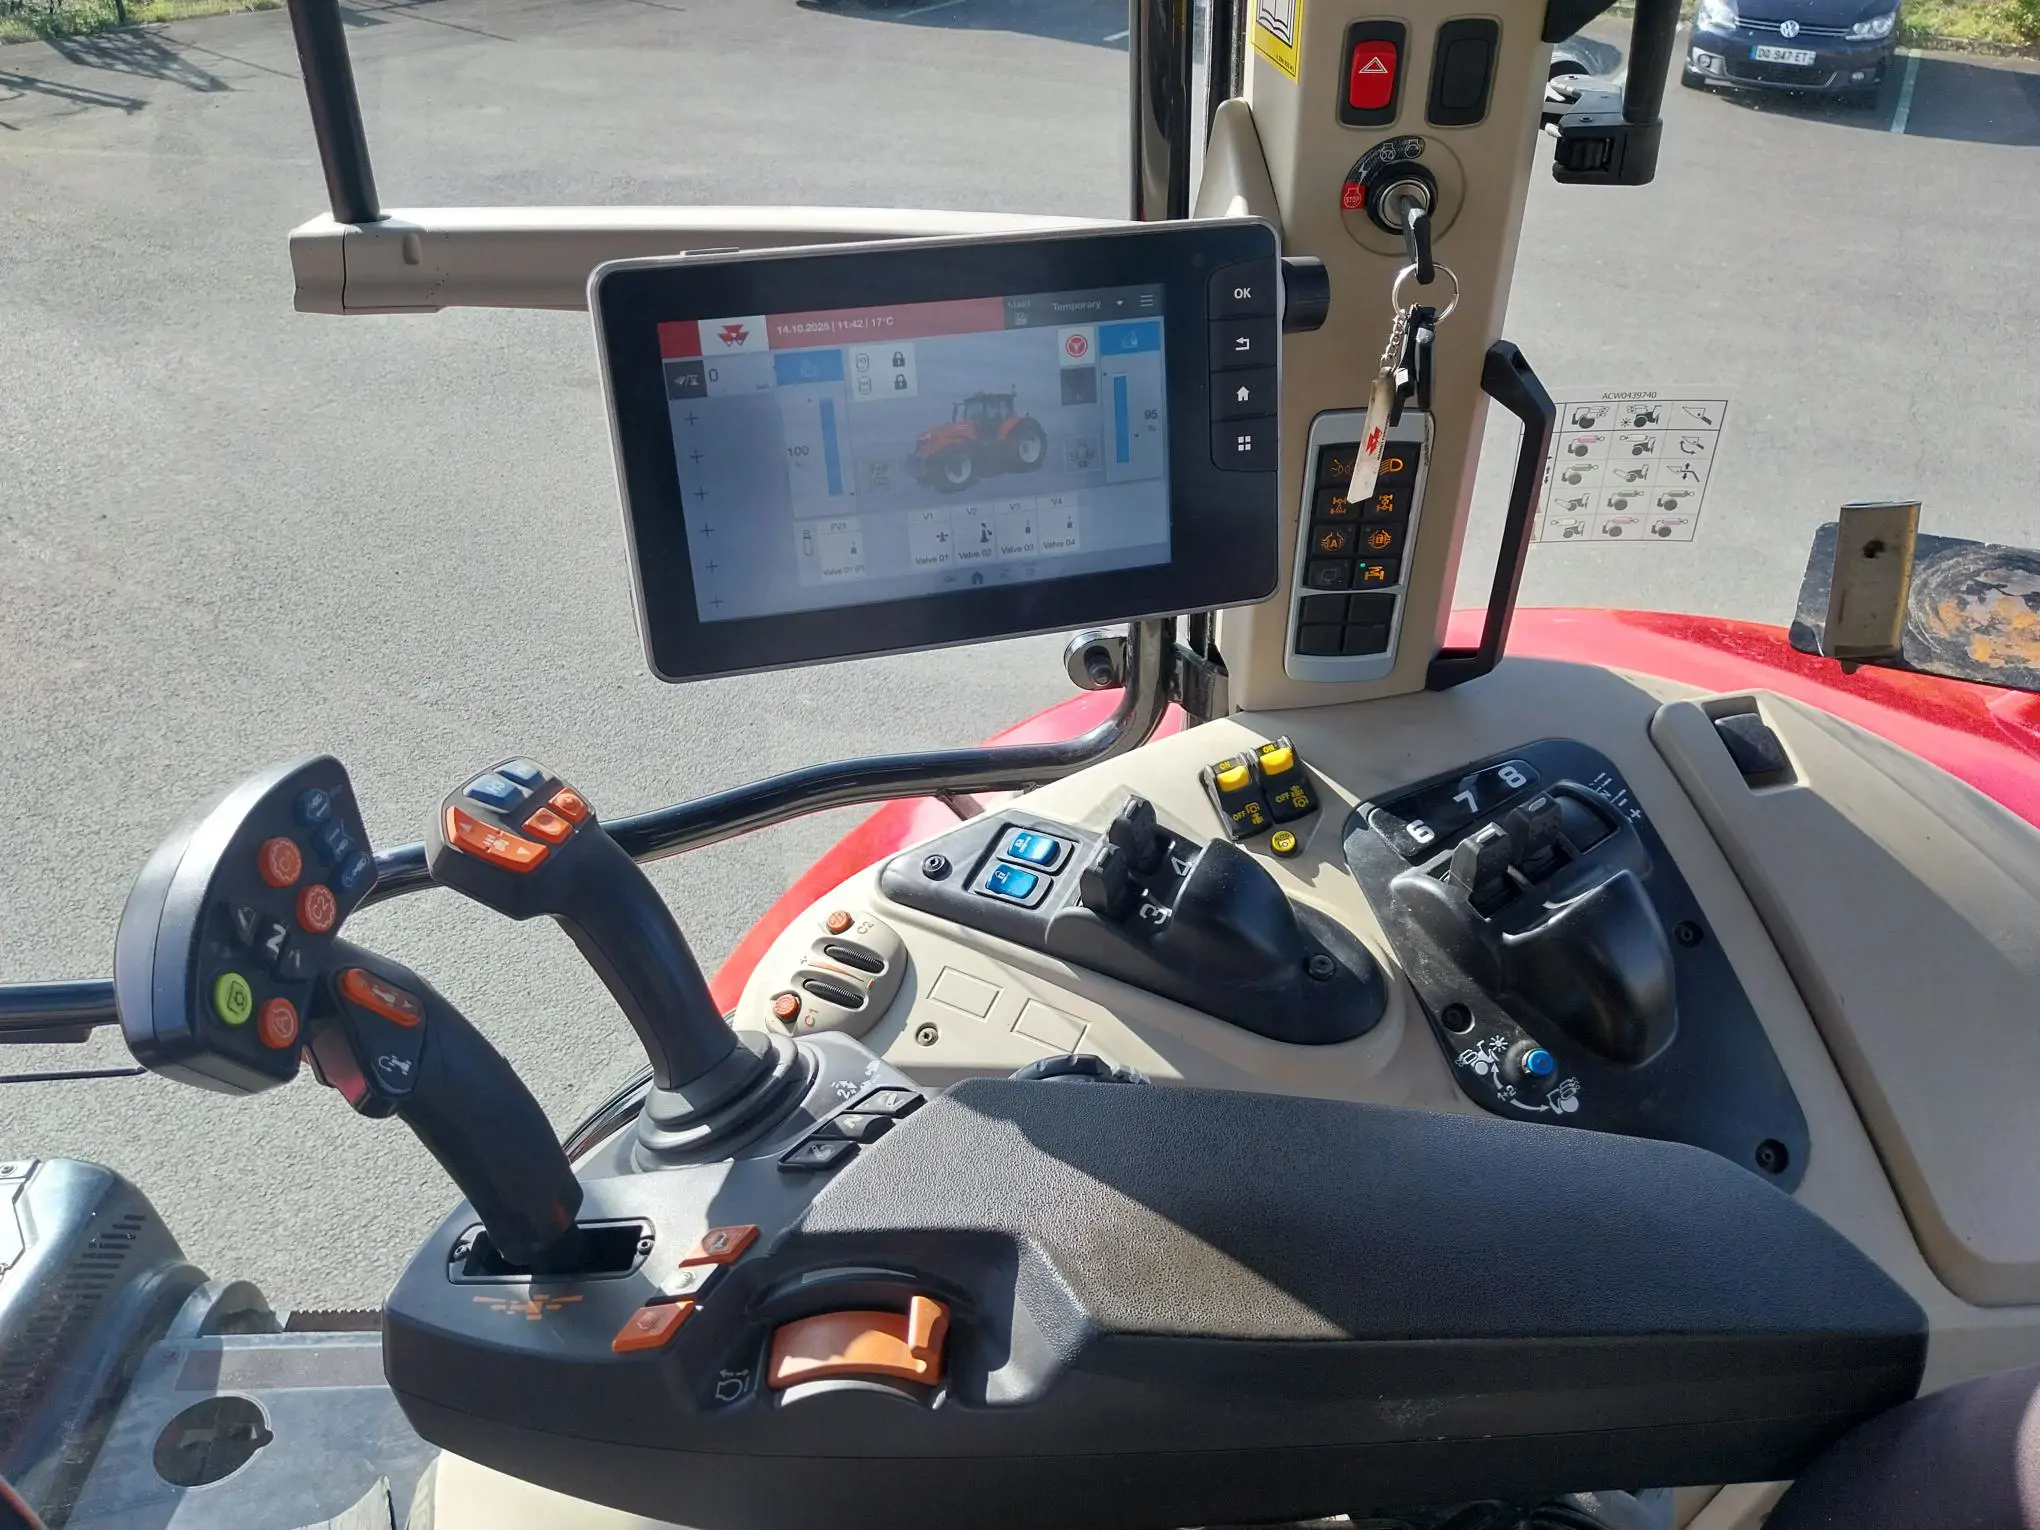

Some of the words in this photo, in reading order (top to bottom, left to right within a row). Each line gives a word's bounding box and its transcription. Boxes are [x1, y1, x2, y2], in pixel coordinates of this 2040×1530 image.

[1346, 195, 1360, 203] STOP
[1234, 287, 1252, 299] OK
[1052, 300, 1101, 312] Temporary
[1144, 409, 1158, 420] 95
[786, 445, 810, 457] 100
[1263, 744, 1275, 753] ON
[1219, 760, 1231, 770] ON
[1498, 765, 1527, 789] 8
[1275, 792, 1291, 803] OFF
[1452, 790, 1479, 813] 7
[1232, 810, 1246, 821] OFF
[1406, 819, 1435, 844] 6
[1140, 904, 1172, 926] 3
[857, 921, 875, 935] C2
[805, 1008, 818, 1027] C1
[1497, 1084, 1517, 1102] 1+2
